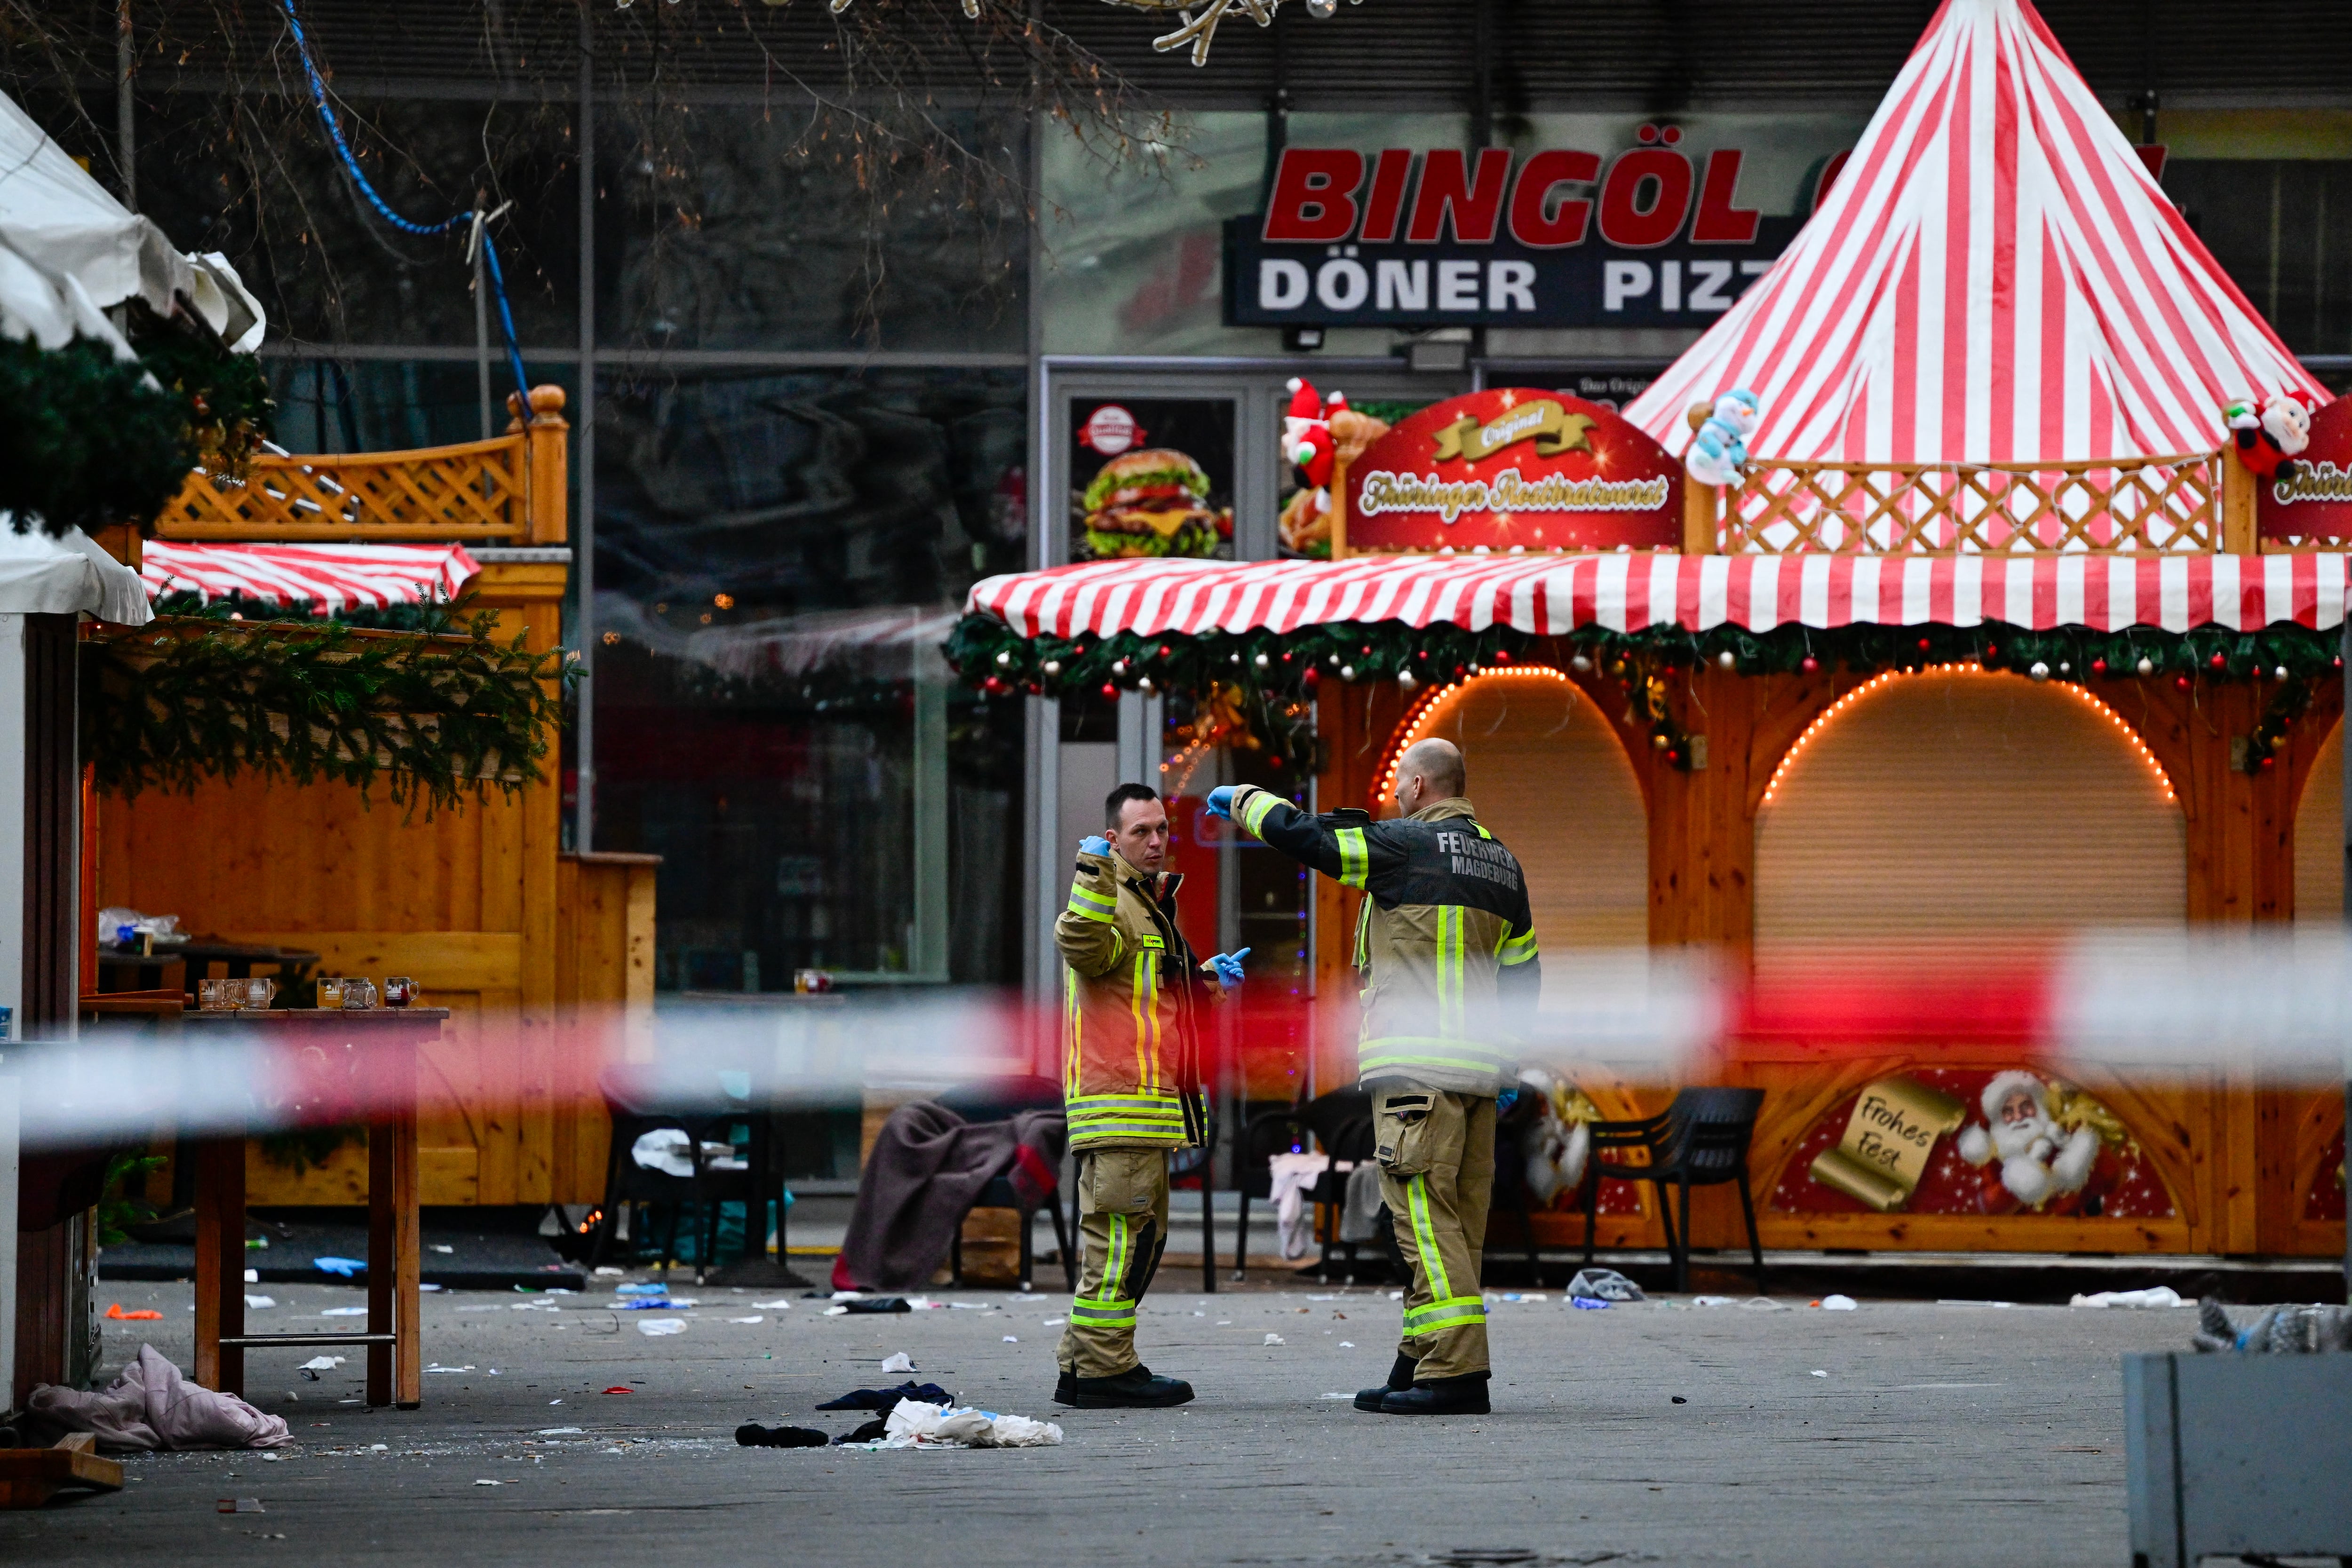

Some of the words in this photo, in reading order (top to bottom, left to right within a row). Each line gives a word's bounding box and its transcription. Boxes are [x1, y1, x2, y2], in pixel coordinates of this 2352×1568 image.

[1263, 125, 1761, 249] BINGÖL
[1258, 246, 1537, 311] DÖNER
[1481, 406, 1545, 447] Original
[1359, 471, 1487, 523] Thüringer
[1489, 468, 1669, 512] Rostbratwurst
[1437, 832, 1518, 871] FEUERWEHR
[1452, 855, 1518, 891] MAGDEBURG
[1861, 1096, 1931, 1148] Frohes
[1858, 1130, 1901, 1171] Fest
